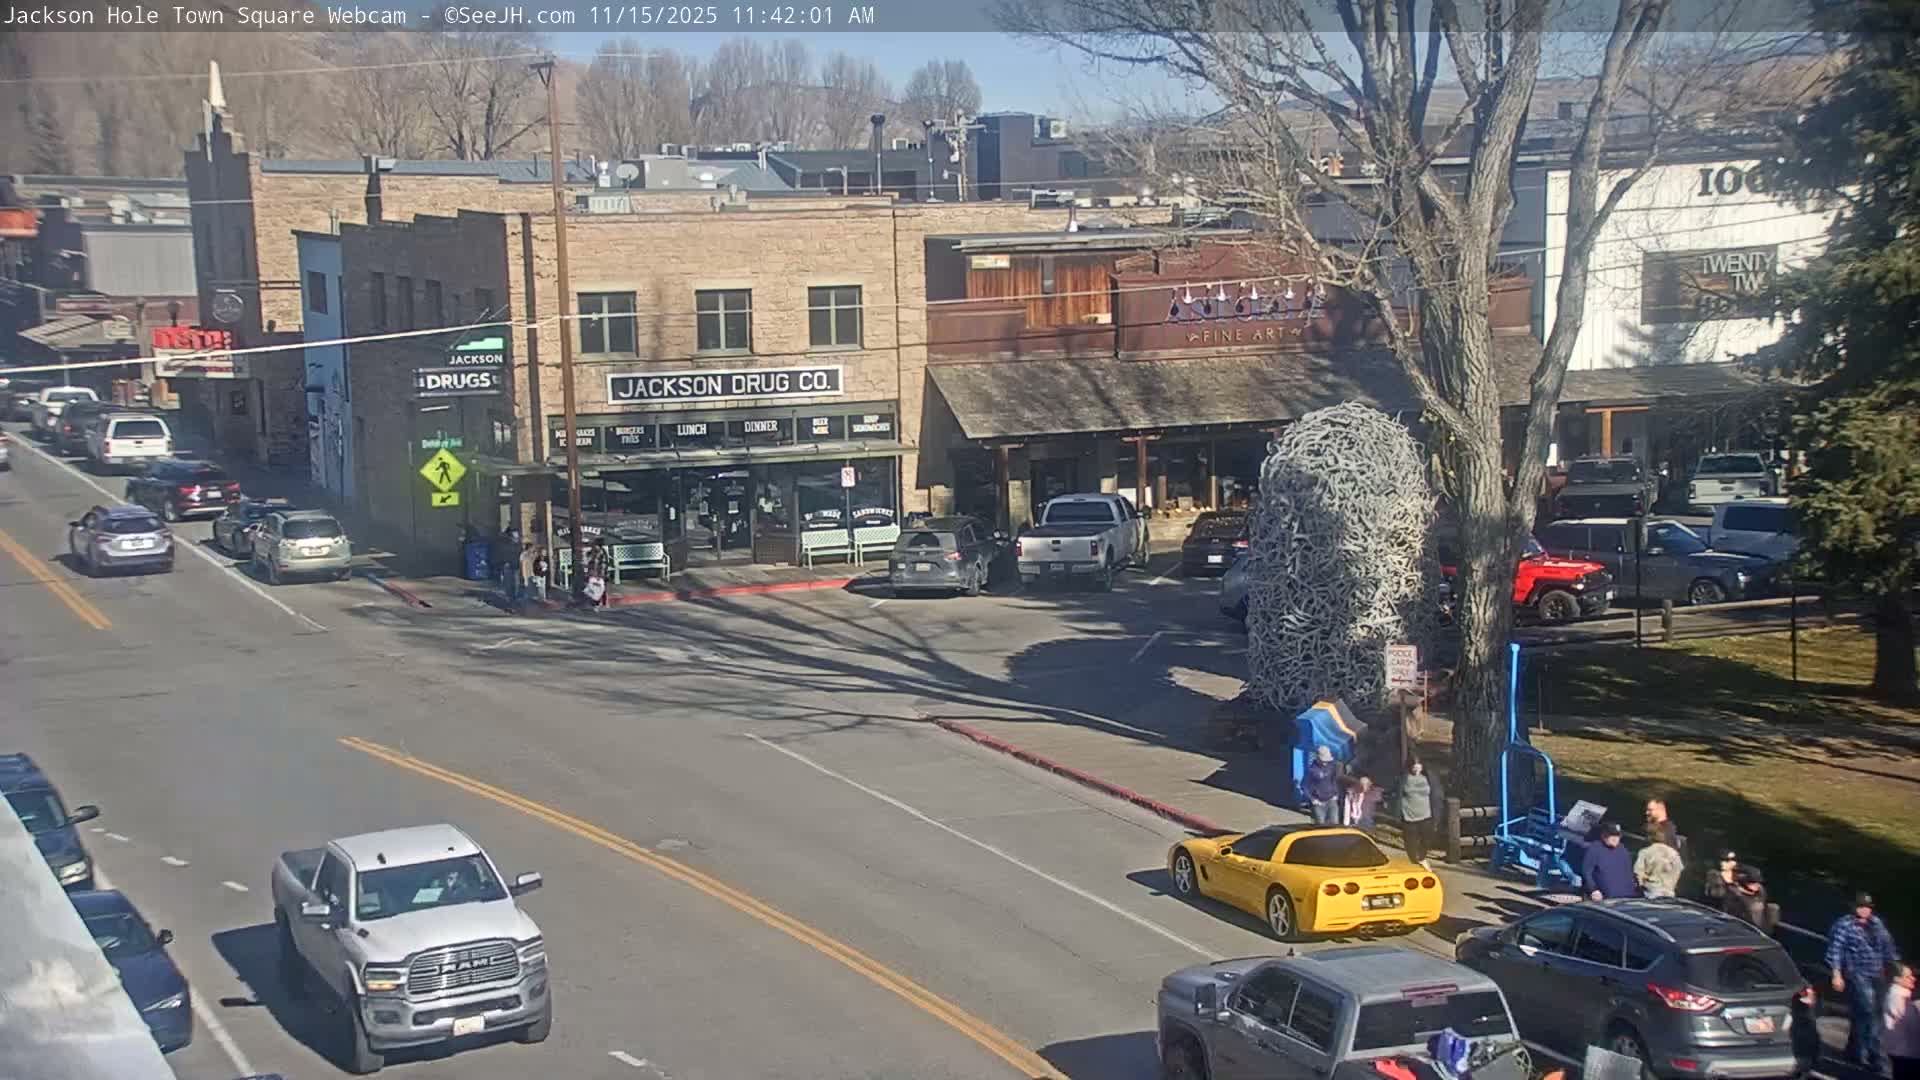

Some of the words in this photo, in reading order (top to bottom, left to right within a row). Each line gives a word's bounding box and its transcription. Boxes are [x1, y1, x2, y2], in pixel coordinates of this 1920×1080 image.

[1700, 251, 1775, 274] TWENTY
[1203, 329, 1243, 343] FINE
[1253, 327, 1285, 341] ART
[448, 354, 503, 365] JACKSON
[426, 372, 491, 390] DRUGS
[619, 375, 722, 398] JACKSON
[732, 373, 789, 394] DRUG
[799, 371, 831, 391] CO.
[677, 423, 707, 436] LUNCH
[744, 420, 778, 432] DINNER
[441, 958, 489, 974] RAM
